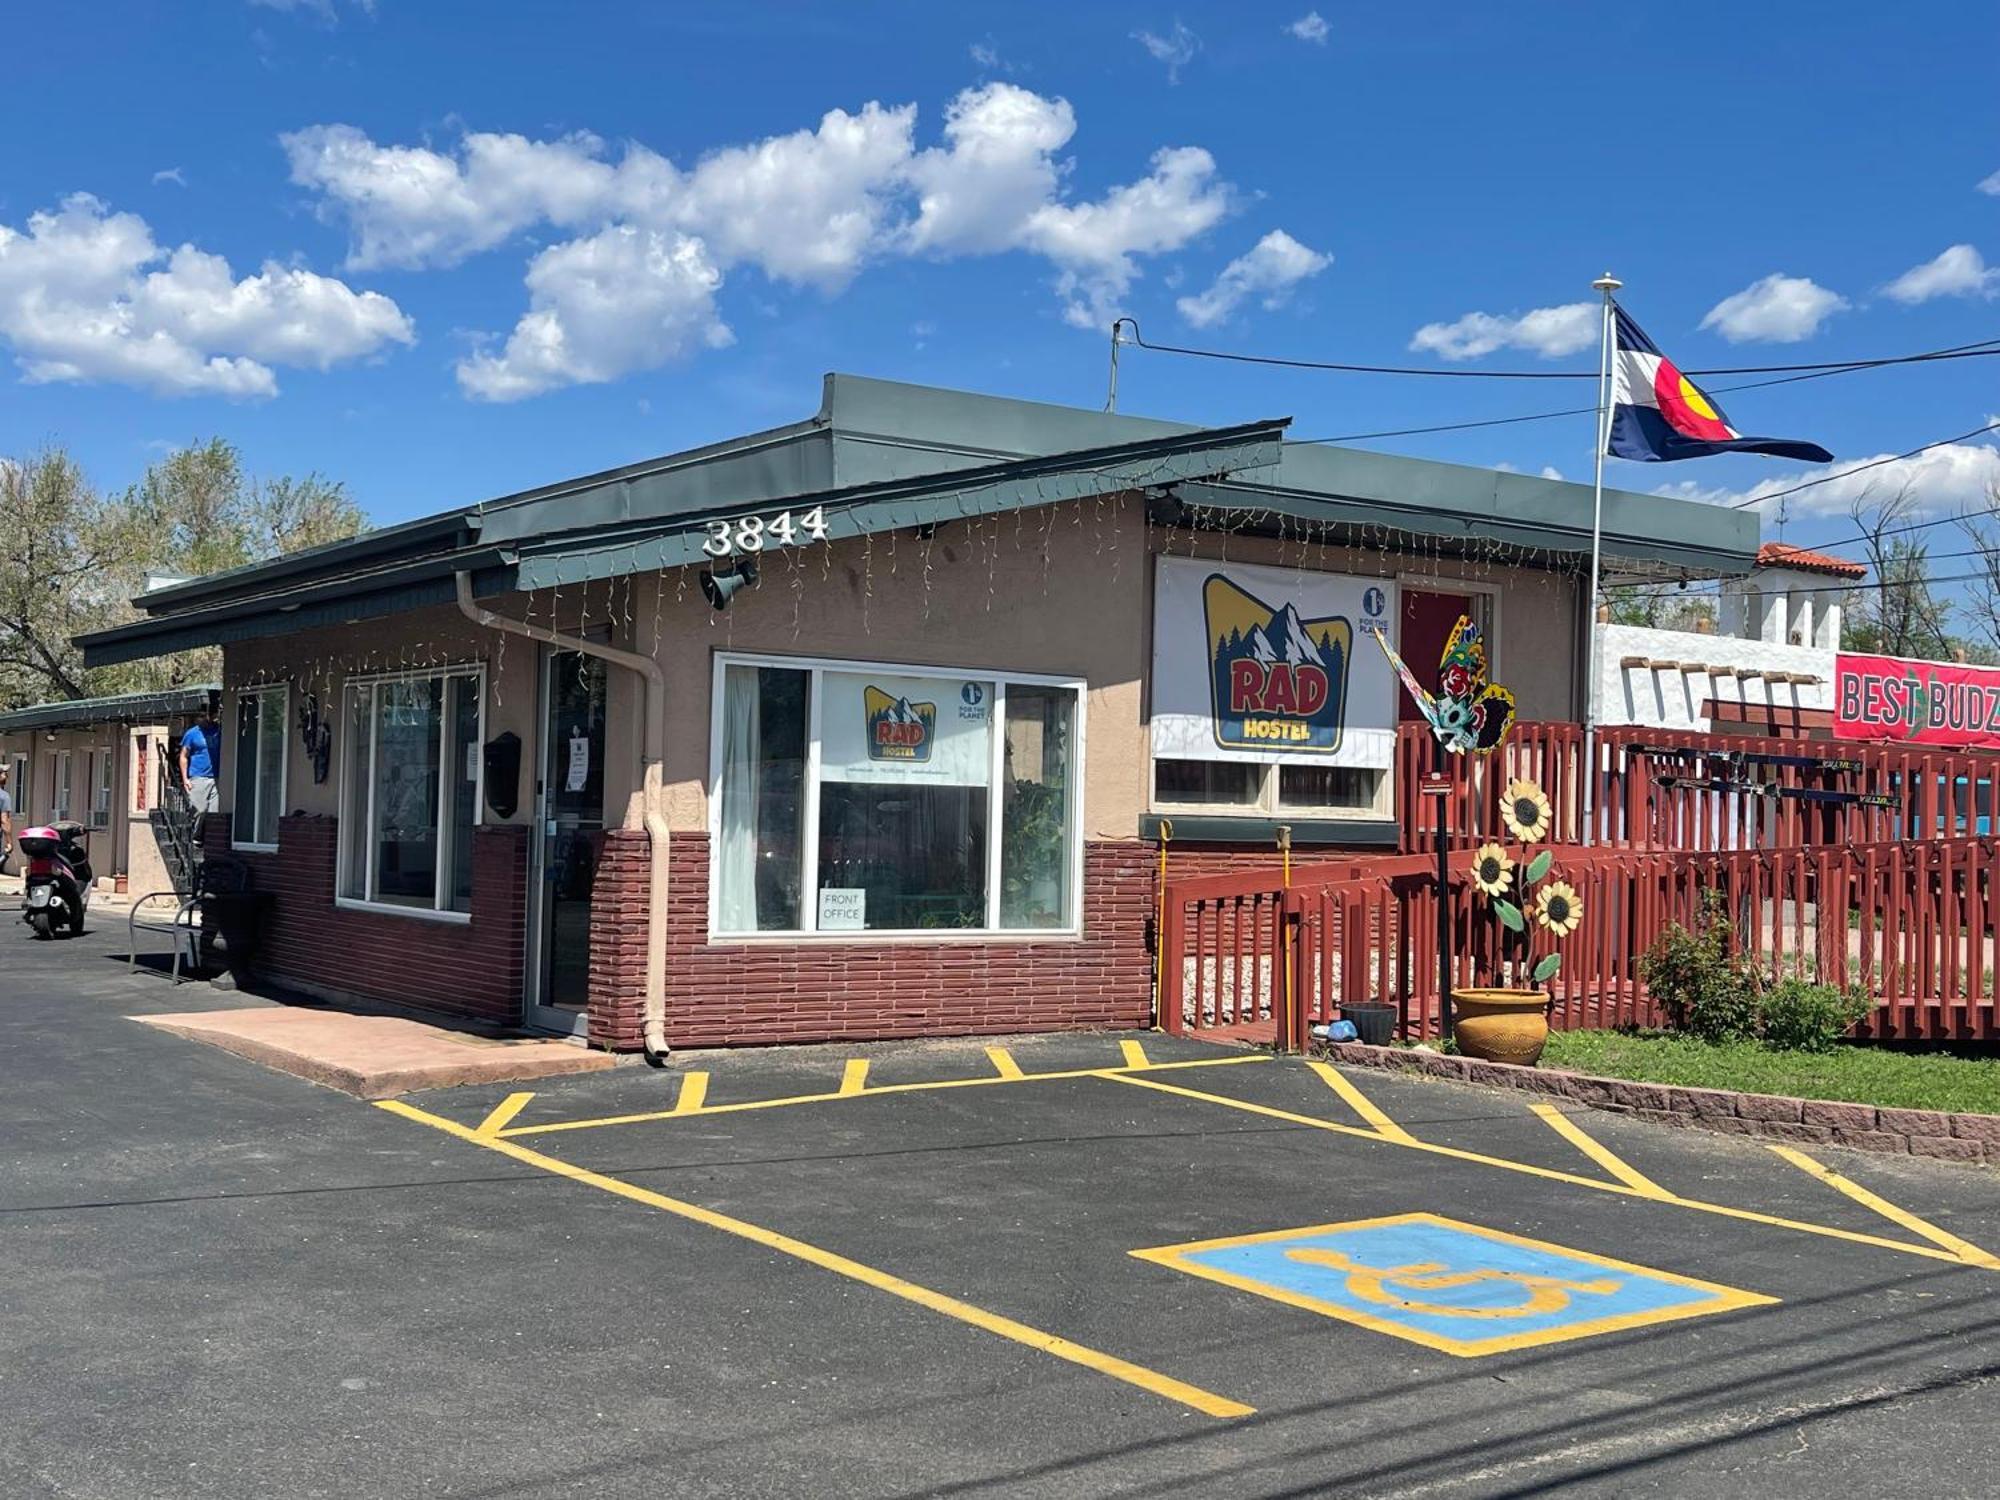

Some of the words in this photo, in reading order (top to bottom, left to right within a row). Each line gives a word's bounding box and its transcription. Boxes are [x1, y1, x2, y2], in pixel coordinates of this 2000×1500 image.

[702, 505, 829, 557] 3844
[1231, 658, 1328, 716] RAD
[1840, 672, 1921, 727] BEST
[959, 712, 985, 720] PLANET
[876, 720, 925, 746] RAD
[1243, 718, 1311, 741] HOSTEL
[882, 746, 915, 757] HOSTEL
[825, 894, 859, 905] FRONT
[823, 908, 859, 919] OFFICE
